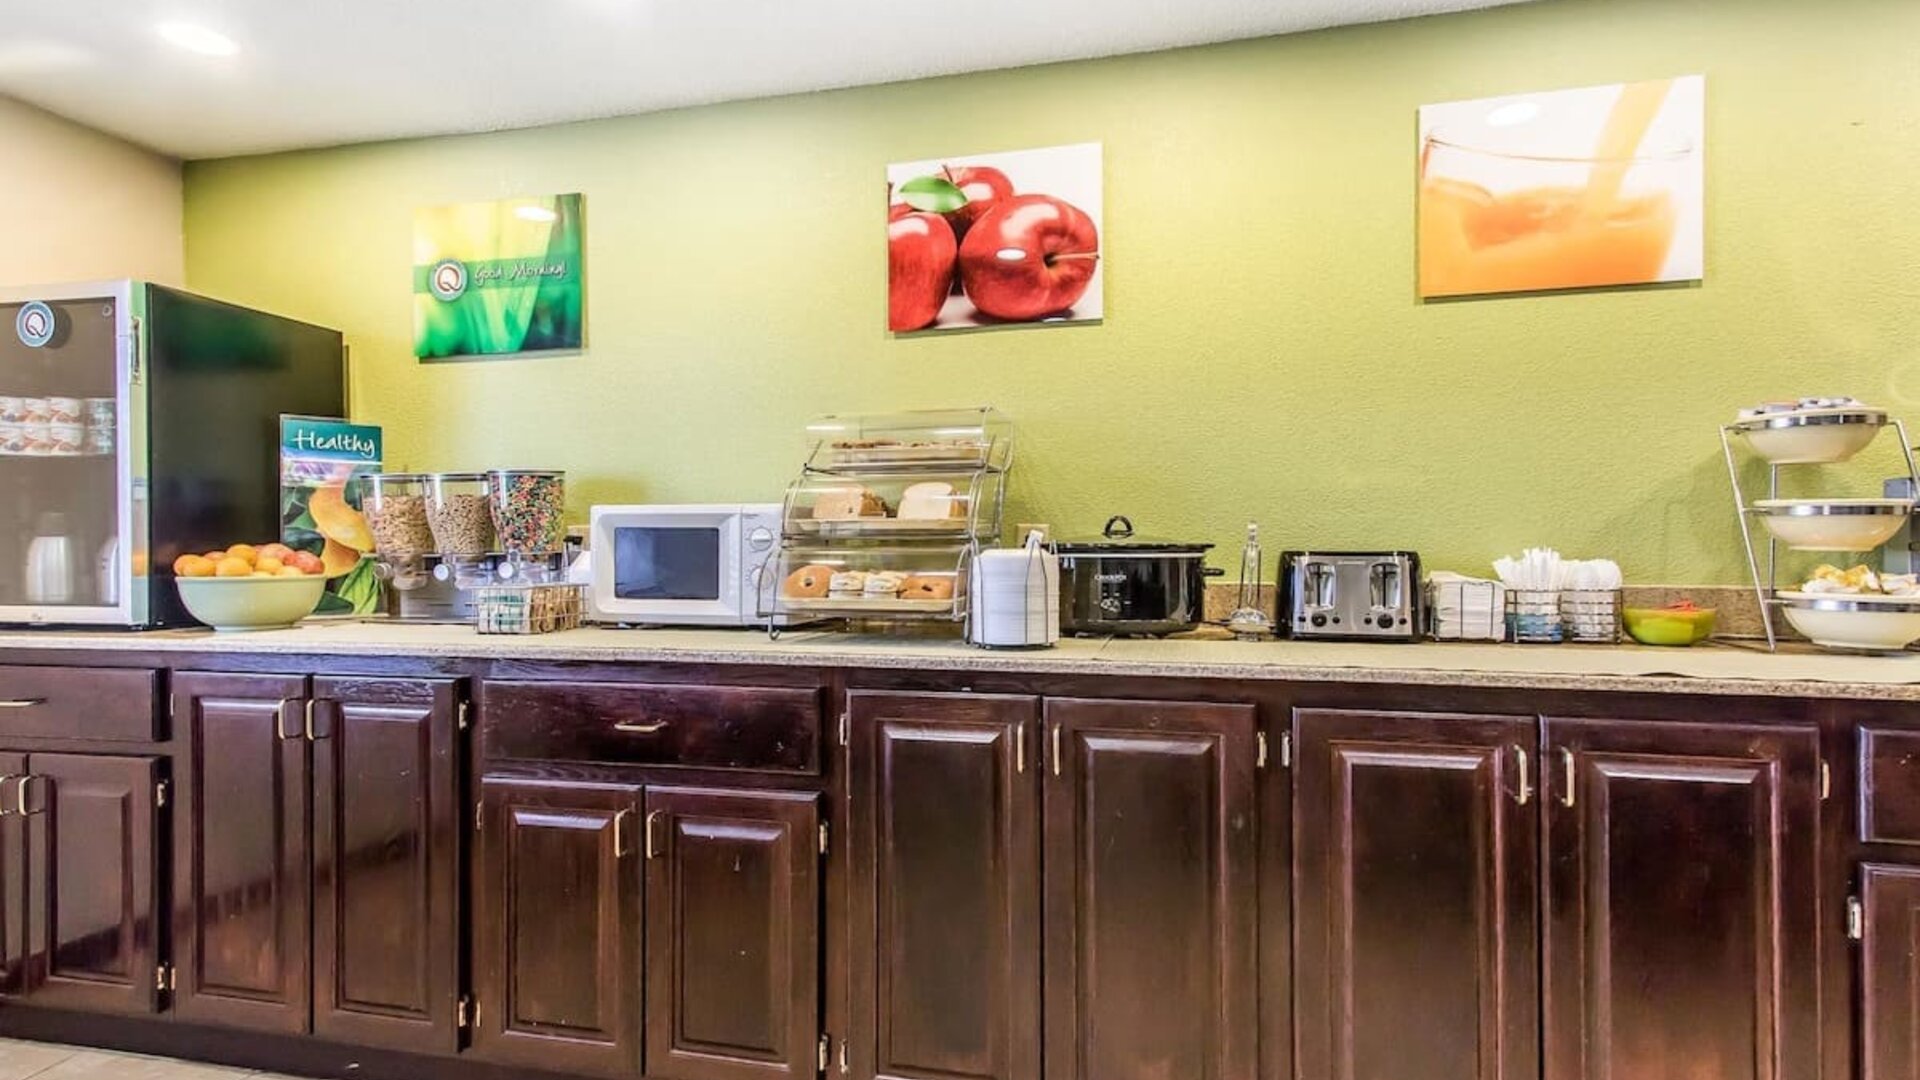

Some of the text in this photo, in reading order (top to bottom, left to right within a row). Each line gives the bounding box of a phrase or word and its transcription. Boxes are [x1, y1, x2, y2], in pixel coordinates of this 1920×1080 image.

[437, 265, 463, 291] Q
[475, 263, 503, 288] Good
[290, 428, 375, 459] Healthy
